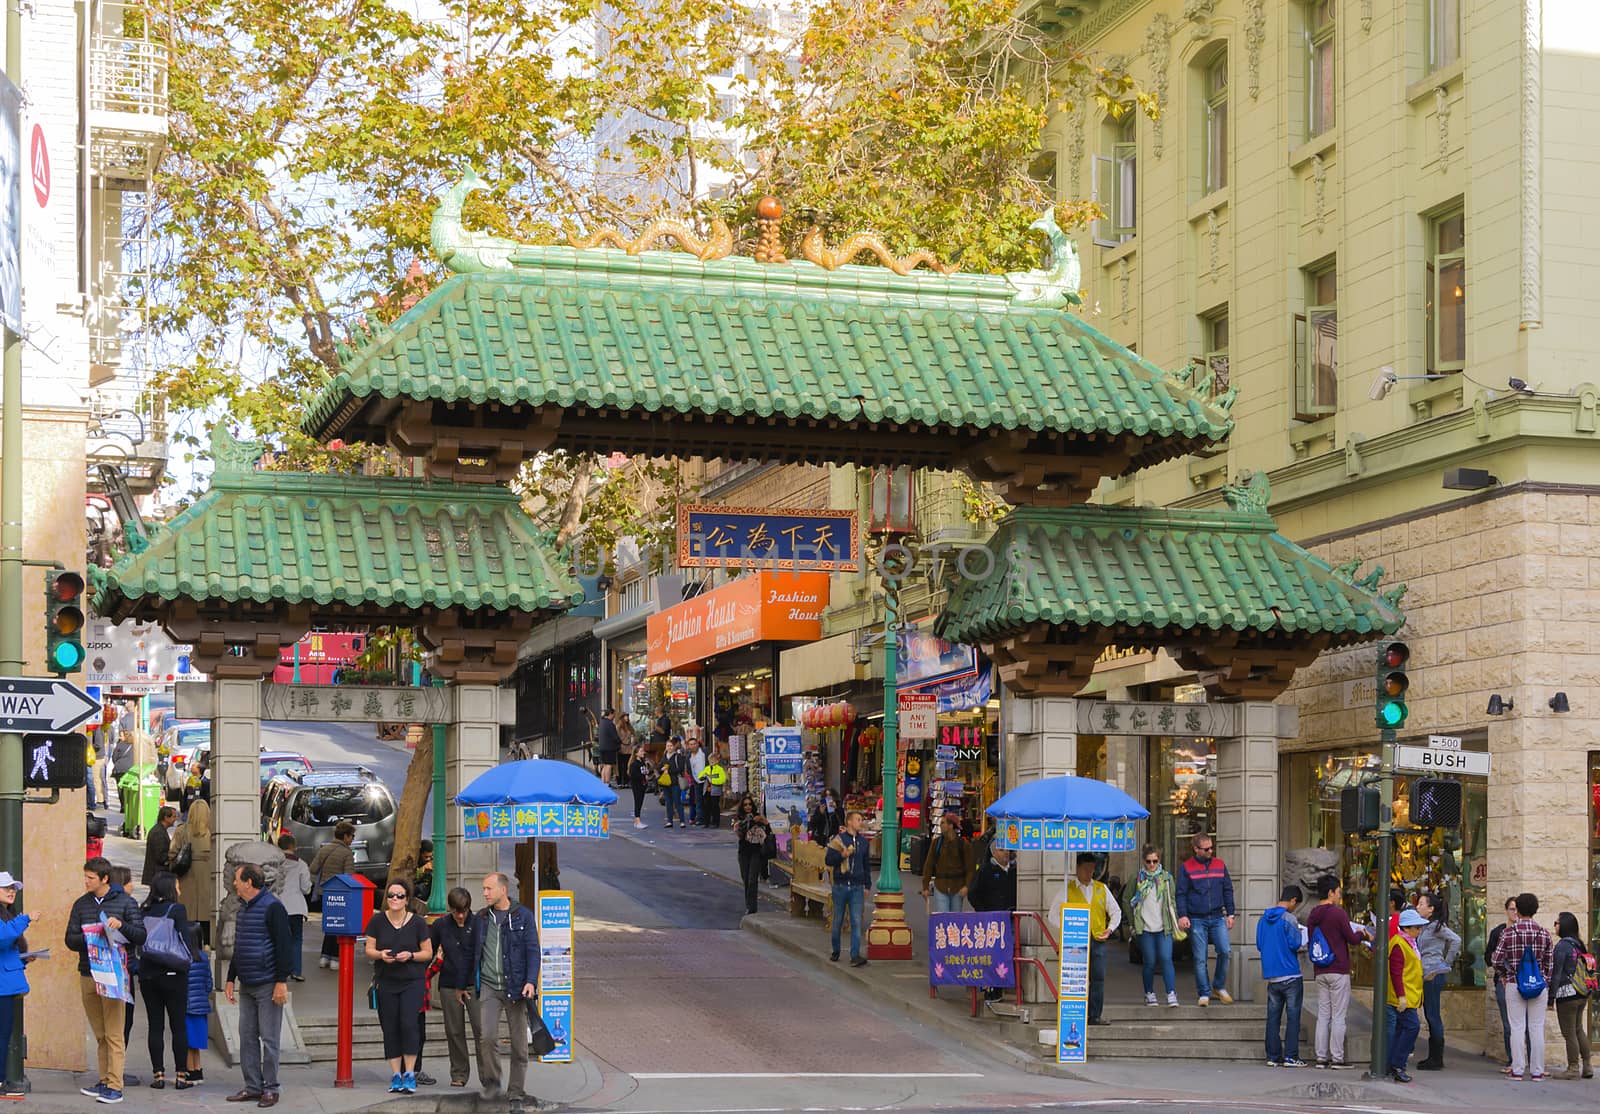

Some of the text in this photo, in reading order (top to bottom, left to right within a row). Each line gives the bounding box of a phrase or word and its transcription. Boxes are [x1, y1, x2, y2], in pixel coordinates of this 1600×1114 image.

[767, 590, 818, 604] Fashion
[665, 597, 736, 653] Fashion House
[87, 642, 113, 650] zippo
[2, 695, 45, 715] WAY
[901, 702, 911, 711] NO
[942, 726, 981, 746] SALE
[1441, 739, 1459, 748] 500
[1422, 753, 1467, 768] BUSH
[493, 808, 600, 827] 法輪大法好
[1023, 826, 1040, 838] Fa
[1045, 826, 1064, 838] Lun
[1069, 826, 1087, 839] Da
[1092, 826, 1109, 839] Fa
